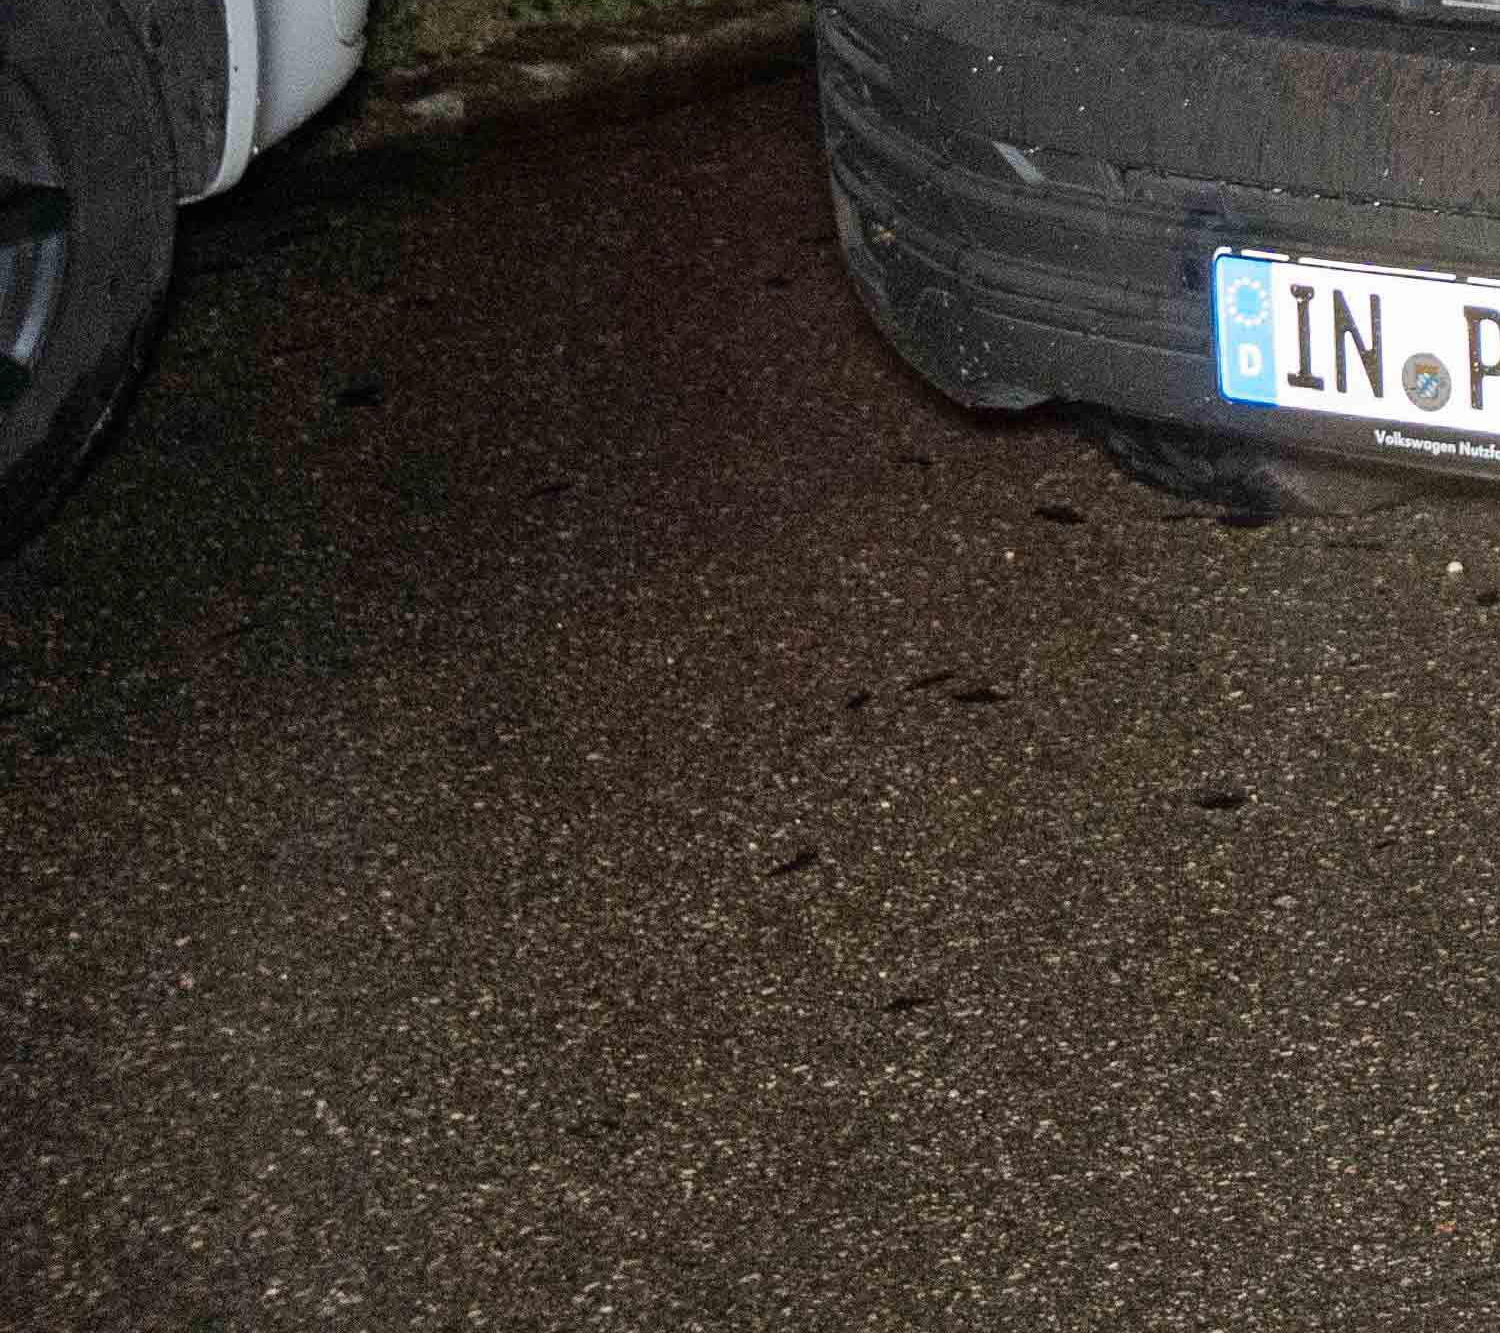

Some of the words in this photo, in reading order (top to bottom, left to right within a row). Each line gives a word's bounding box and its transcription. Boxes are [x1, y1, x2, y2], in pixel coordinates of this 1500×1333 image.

[1236, 341, 1264, 378] D
[1287, 283, 1384, 399] IN
[1374, 429, 1457, 456] Volkswagen
